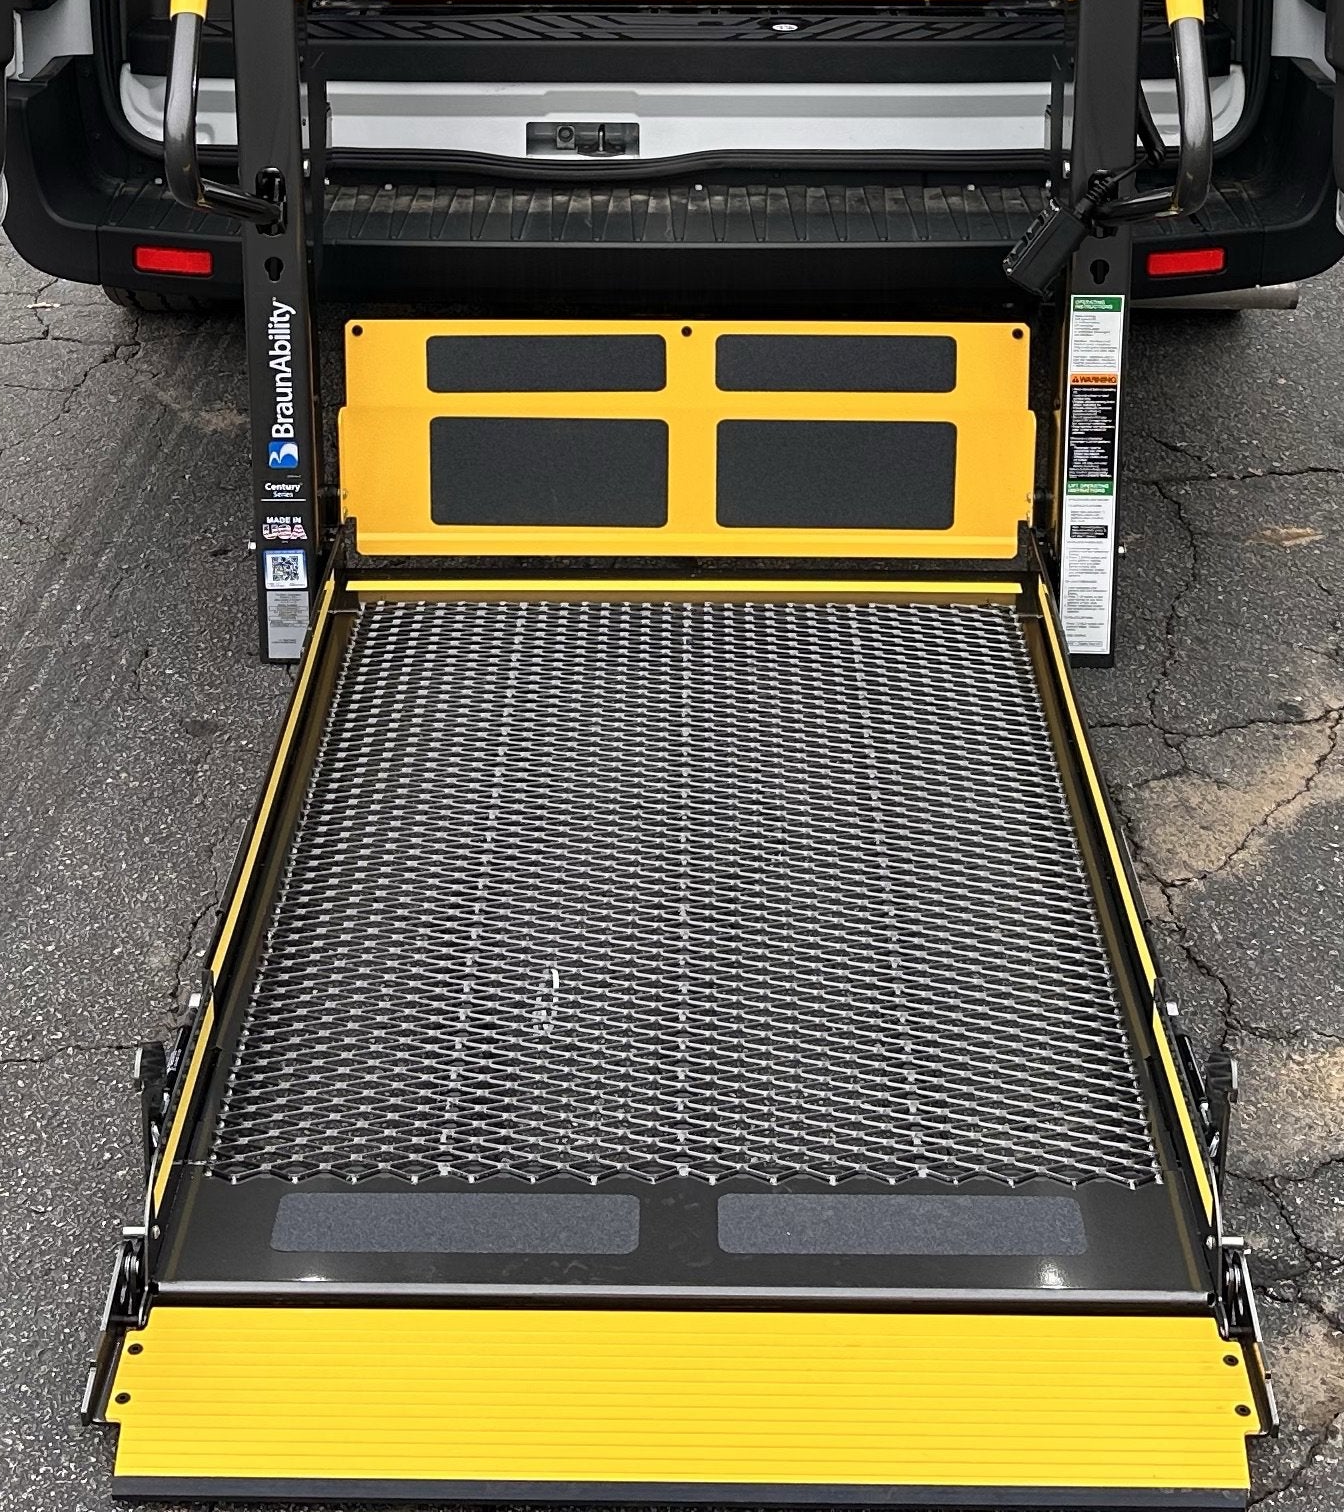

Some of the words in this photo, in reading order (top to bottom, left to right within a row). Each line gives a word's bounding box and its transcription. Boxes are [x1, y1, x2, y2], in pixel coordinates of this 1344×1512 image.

[268, 300, 296, 438] BraunAbility
[1080, 376, 1117, 384] WARNING
[265, 482, 301, 492] Century
[266, 516, 291, 524] MADE
[292, 516, 302, 524] IN
[262, 524, 308, 539] USA
